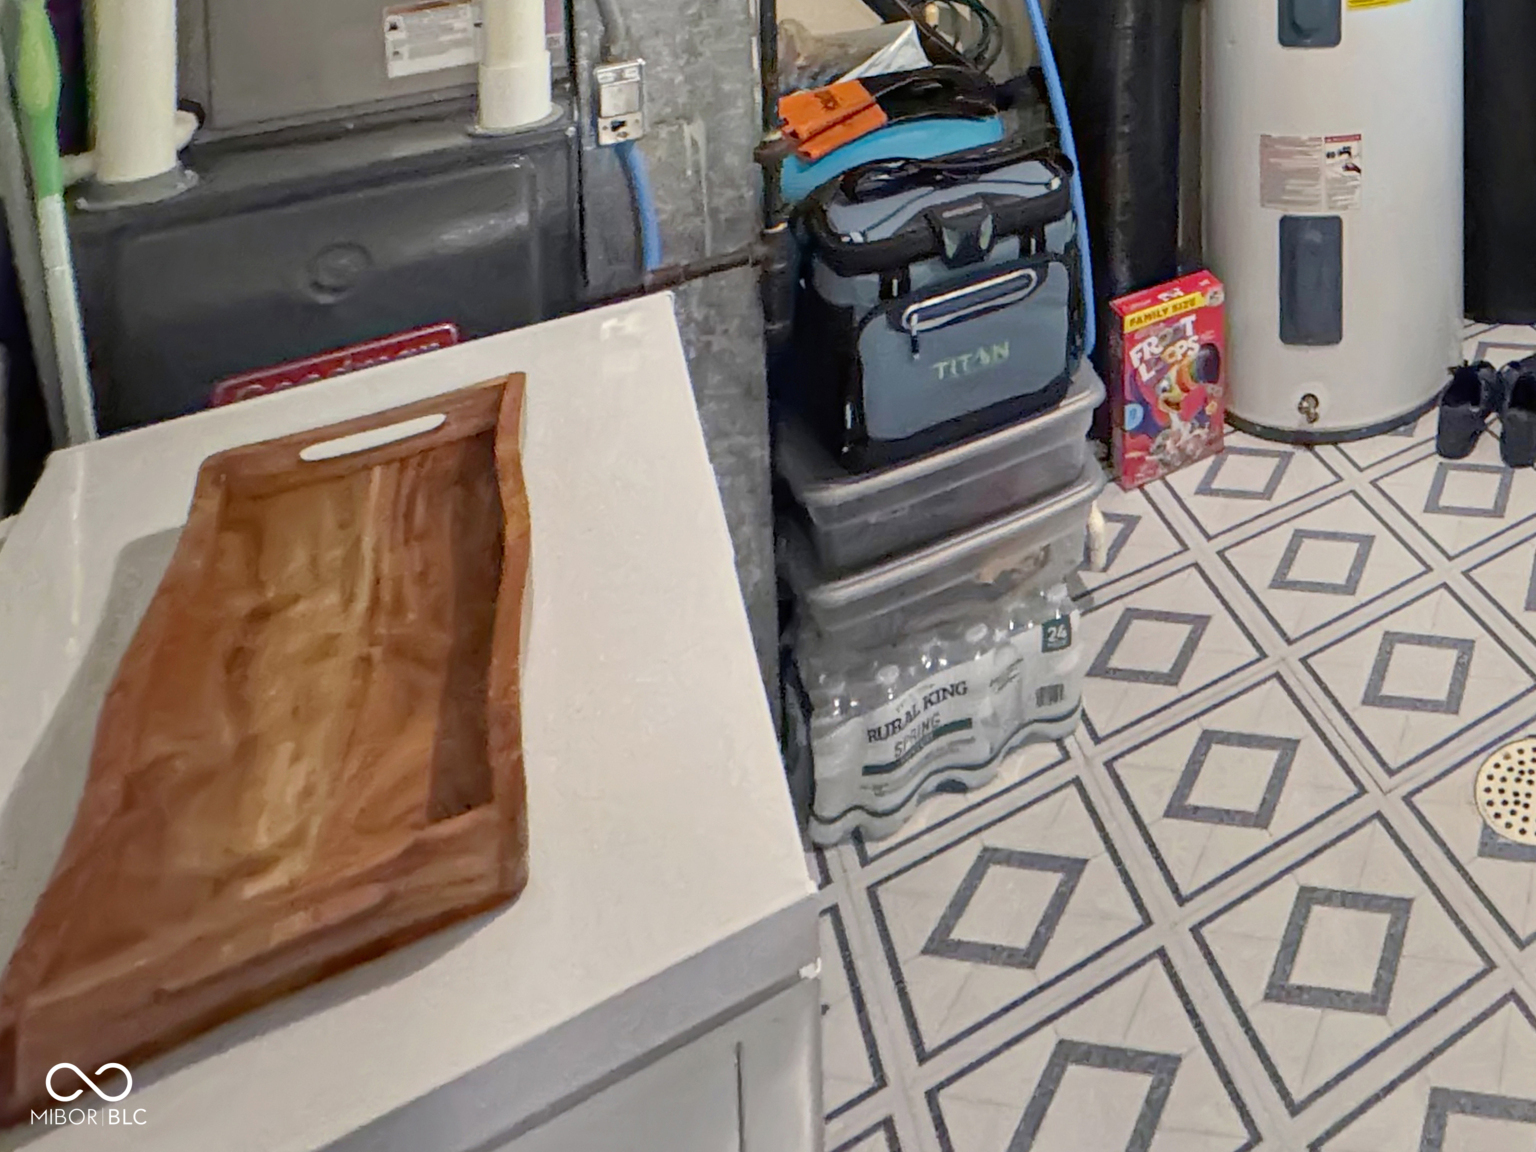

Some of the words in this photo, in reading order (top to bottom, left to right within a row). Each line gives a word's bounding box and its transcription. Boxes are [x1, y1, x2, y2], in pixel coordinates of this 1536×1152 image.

[1129, 308, 1169, 327] FAMILY
[1171, 297, 1197, 313] SIZE
[932, 341, 1009, 380] TITAN
[1047, 624, 1067, 642] 24
[867, 703, 921, 743] RURAL
[922, 680, 968, 709] KING
[894, 712, 941, 758] SPRING
